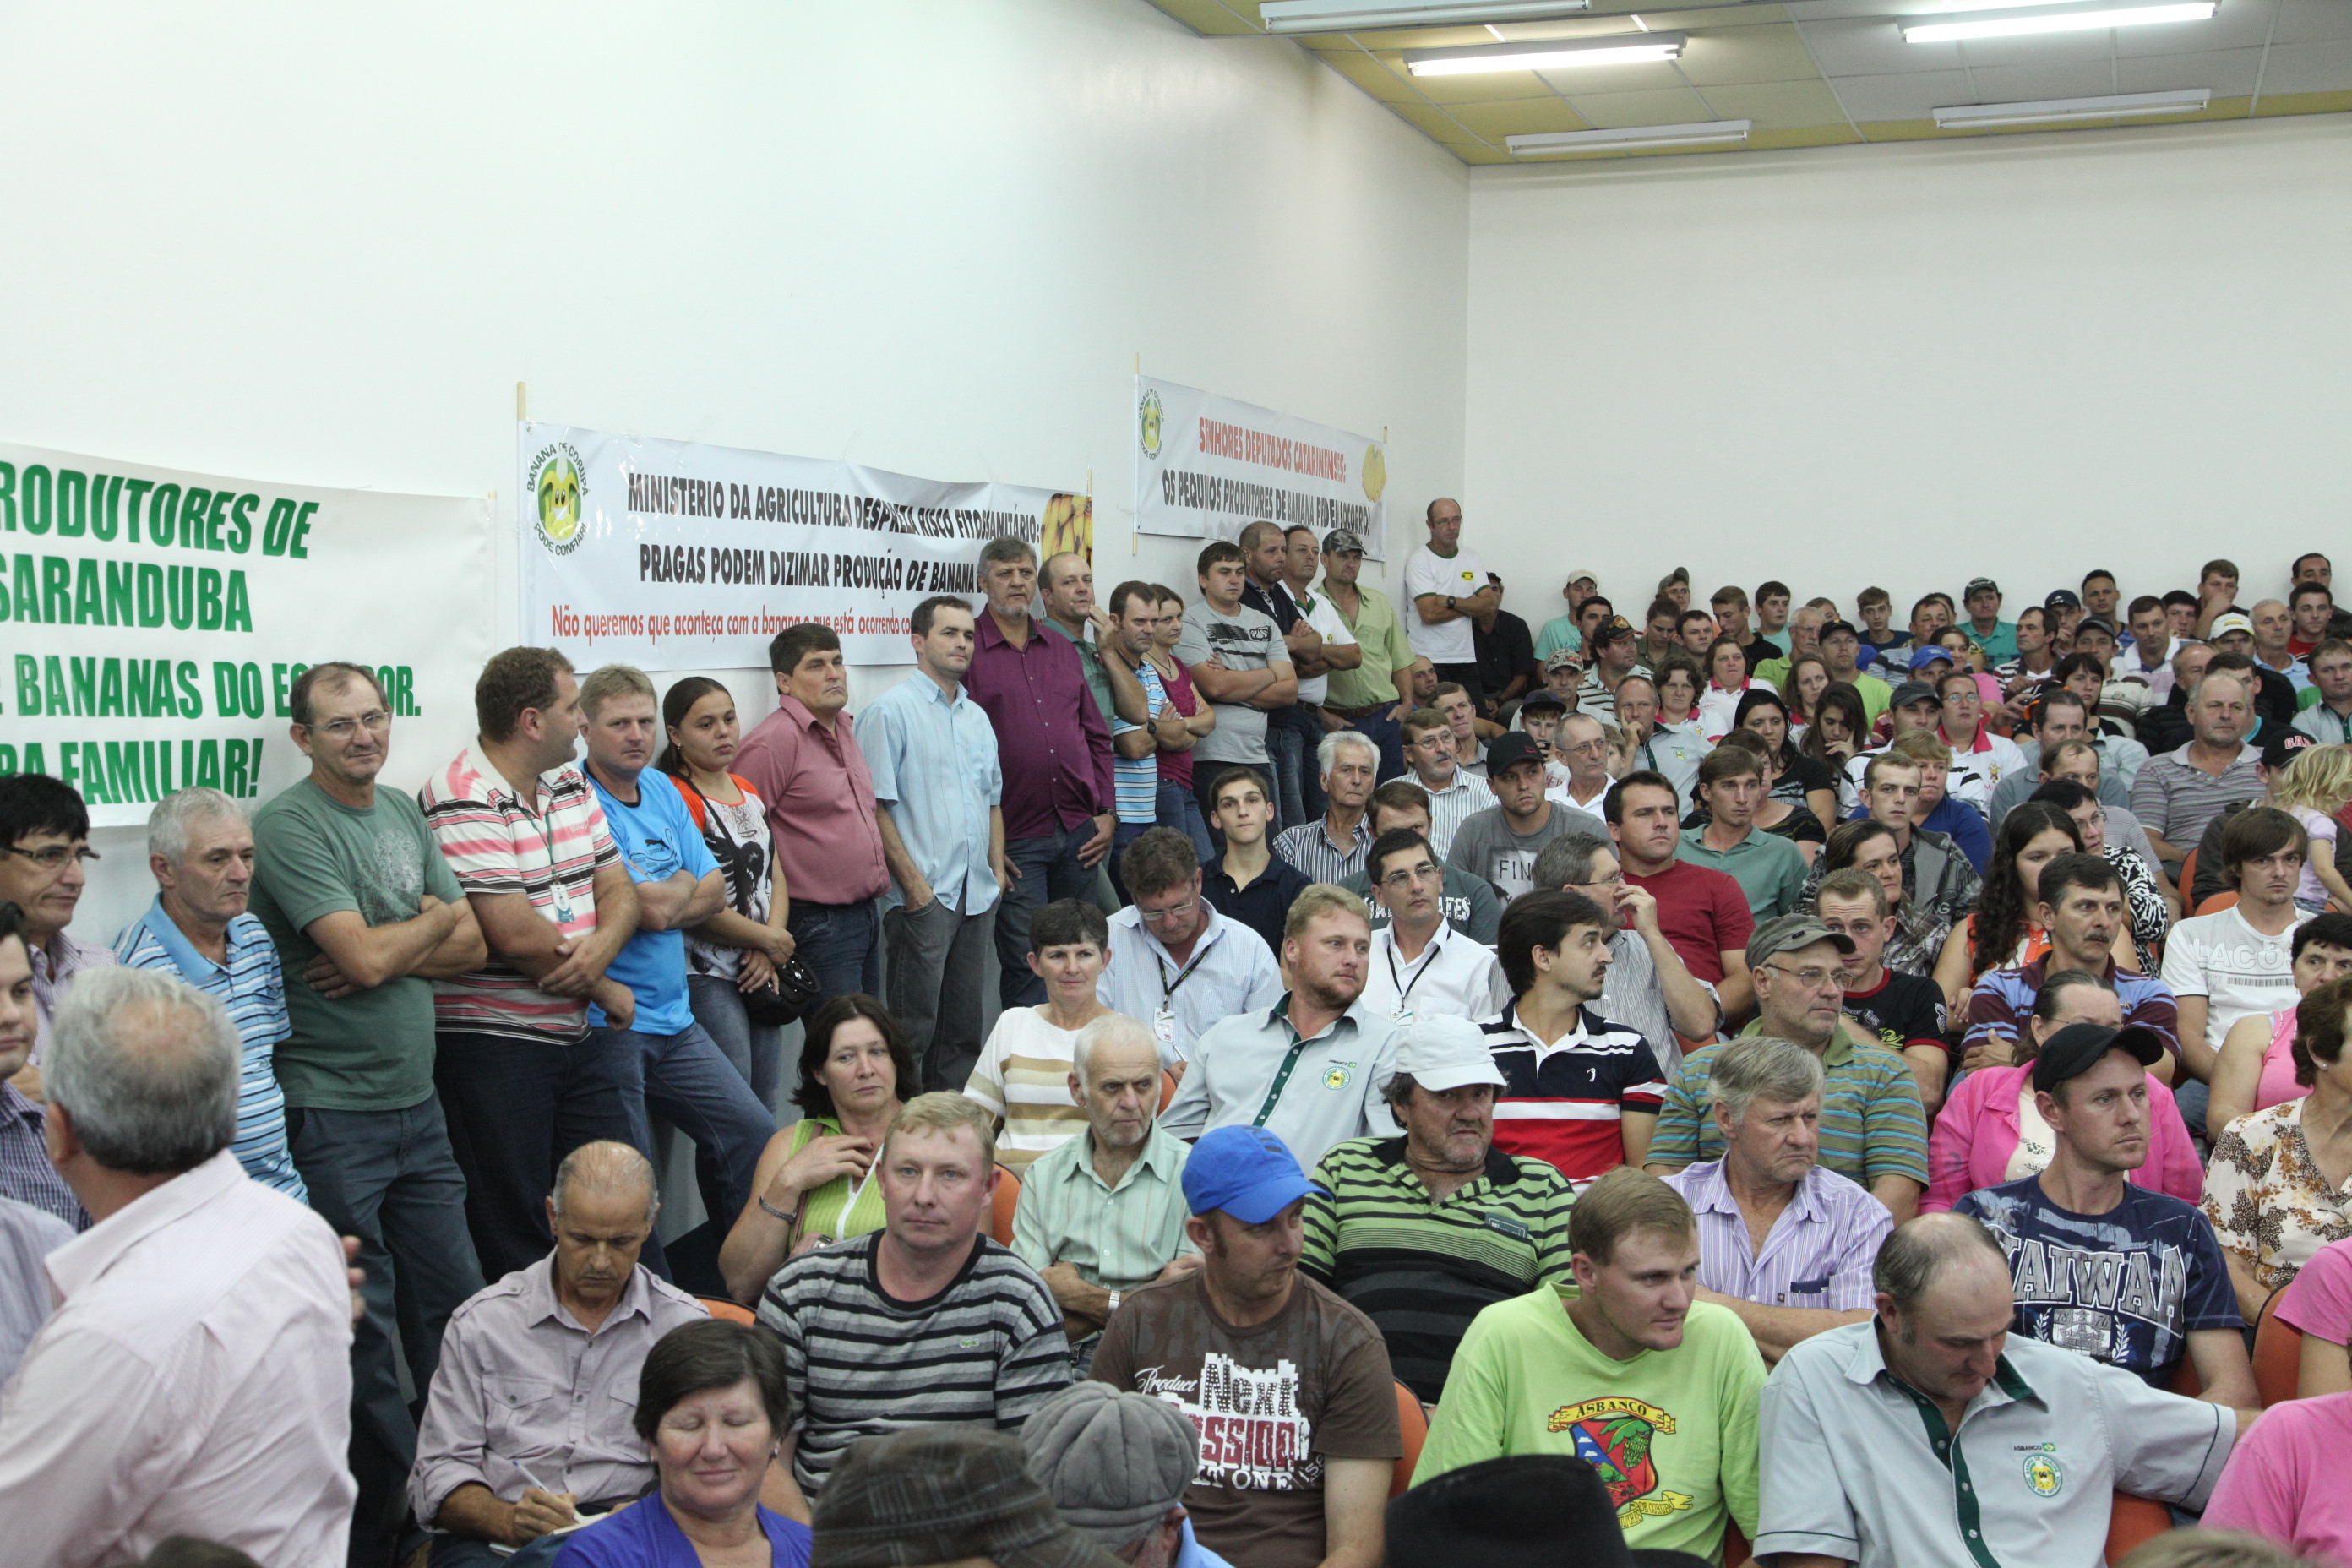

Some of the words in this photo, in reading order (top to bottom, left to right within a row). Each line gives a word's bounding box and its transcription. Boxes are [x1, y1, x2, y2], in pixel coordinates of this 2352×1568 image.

[526, 444, 557, 492] BANANA
[569, 445, 591, 496] CORUPÁ
[1245, 429, 1292, 471] DEPUTADOS
[628, 473, 725, 519] MINISTERIO
[730, 482, 752, 520] DA
[755, 486, 853, 528] AGRICULTURA
[917, 508, 955, 539] RISCO
[1162, 468, 1176, 506] OS
[1223, 479, 1274, 520] PRODUTORES
[1276, 488, 1287, 521] DE
[263, 497, 320, 559] DE
[534, 523, 554, 553] PODE
[640, 543, 706, 585] PRAGAS
[710, 547, 766, 585] PODEM
[770, 551, 830, 588] DIZIMAR
[834, 548, 903, 600] PRODUÇÃO
[906, 560, 928, 591] DE
[928, 561, 974, 594] BANANA
[552, 604, 580, 637] Não
[584, 614, 644, 647] queremos
[648, 614, 670, 645] que
[673, 609, 724, 643] aconteça
[727, 614, 749, 635] com
[751, 615, 759, 635] a
[833, 607, 854, 634] está
[858, 607, 900, 635] ocorrendo
[901, 618, 912, 635] co
[14, 654, 204, 719] BANANAS
[213, 661, 264, 719] DO
[59, 738, 264, 806] FAMILIAR!
[1135, 1365, 1198, 1396] Product
[1203, 1363, 1292, 1417] Next
[1576, 1400, 1647, 1419] ASBANCO
[1231, 1471, 1293, 1490] ONE
